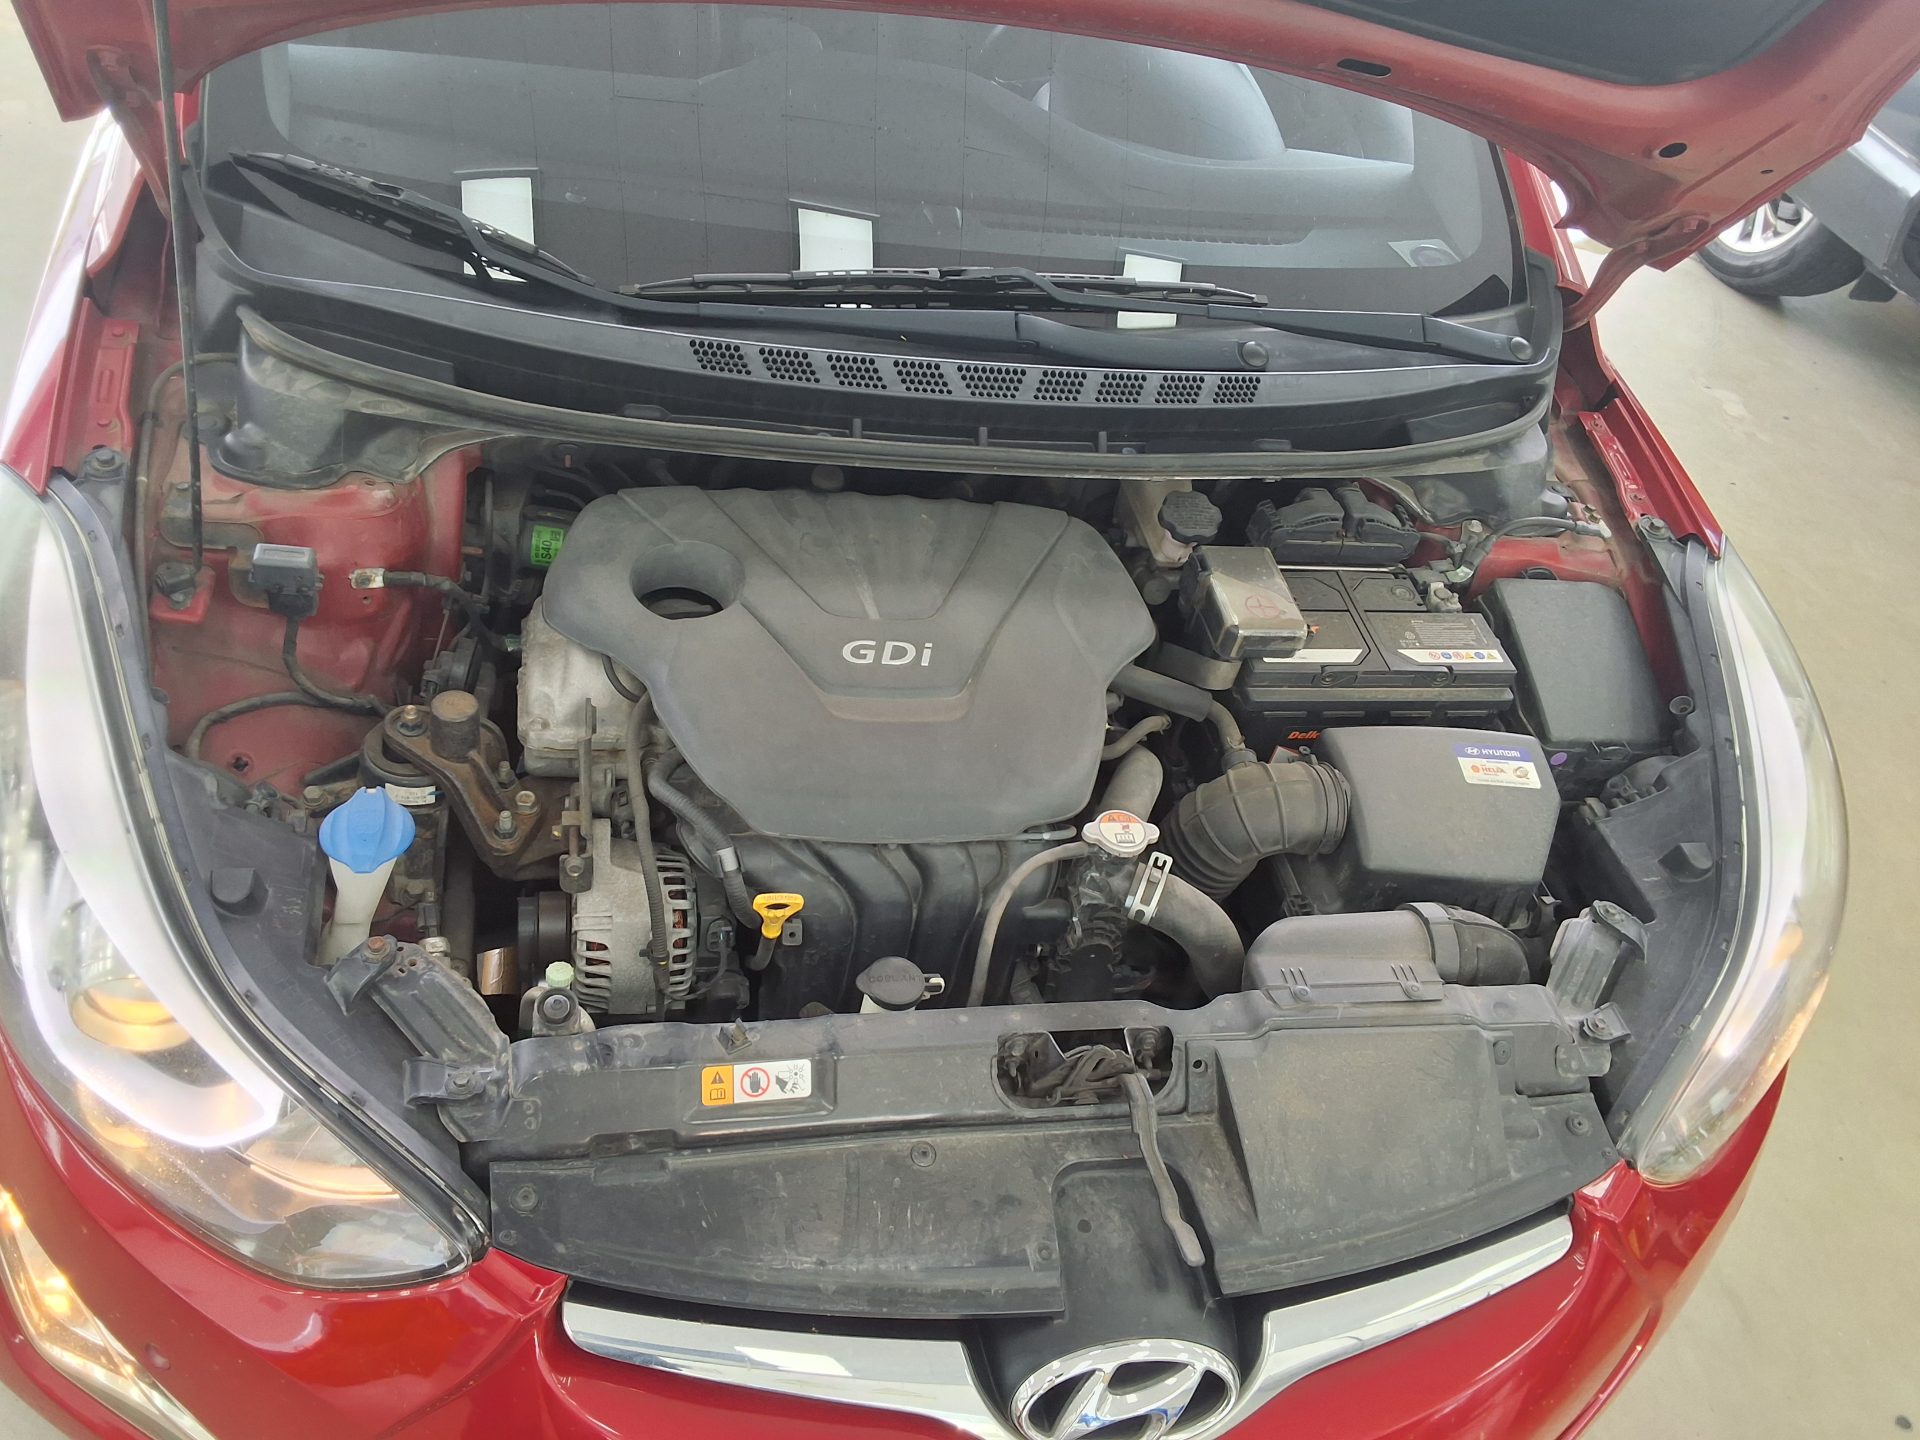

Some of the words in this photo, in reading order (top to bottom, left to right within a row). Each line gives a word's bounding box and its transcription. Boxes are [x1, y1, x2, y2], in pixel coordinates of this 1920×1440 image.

[541, 540, 553, 560] S40
[842, 640, 933, 666] GDi
[1481, 748, 1521, 758] HYUNDAI
